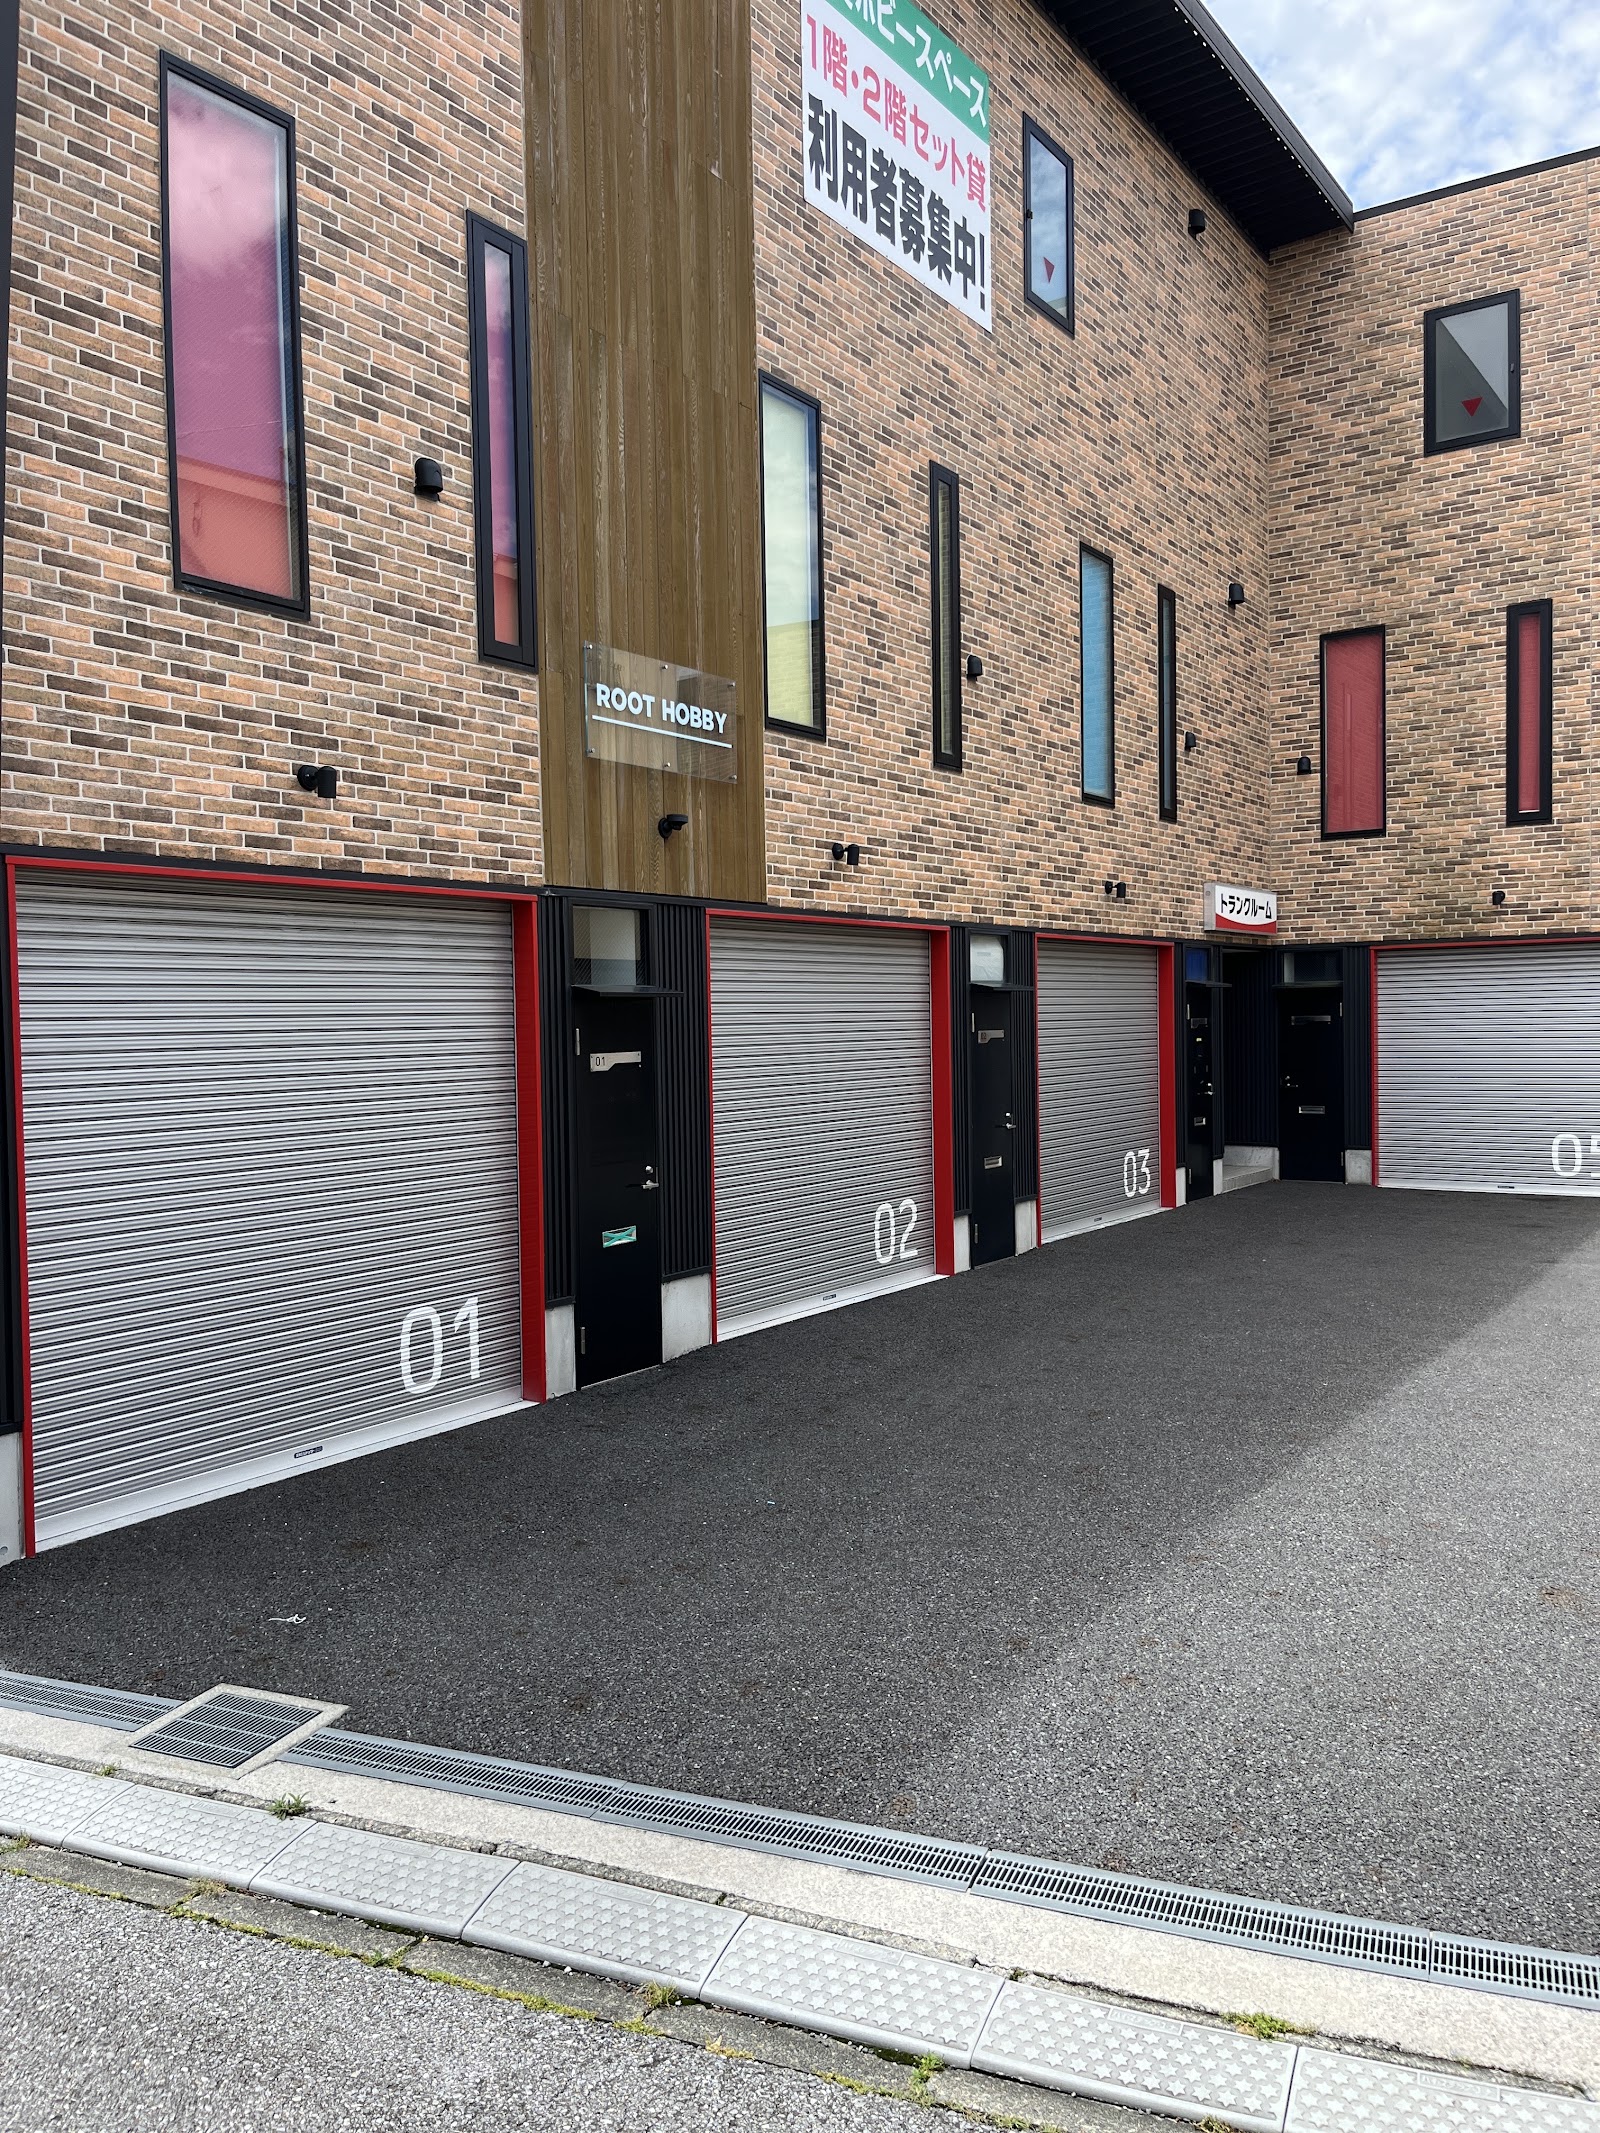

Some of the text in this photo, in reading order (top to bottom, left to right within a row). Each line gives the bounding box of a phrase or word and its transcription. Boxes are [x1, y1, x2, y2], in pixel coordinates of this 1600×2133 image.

[596, 683, 727, 733] ROOT HOBBY
[1220, 893, 1272, 919] トランクルーム
[596, 1056, 606, 1067] 01
[1123, 1148, 1151, 1198] 03
[874, 1198, 919, 1264] 02
[400, 1296, 481, 1394] 01
